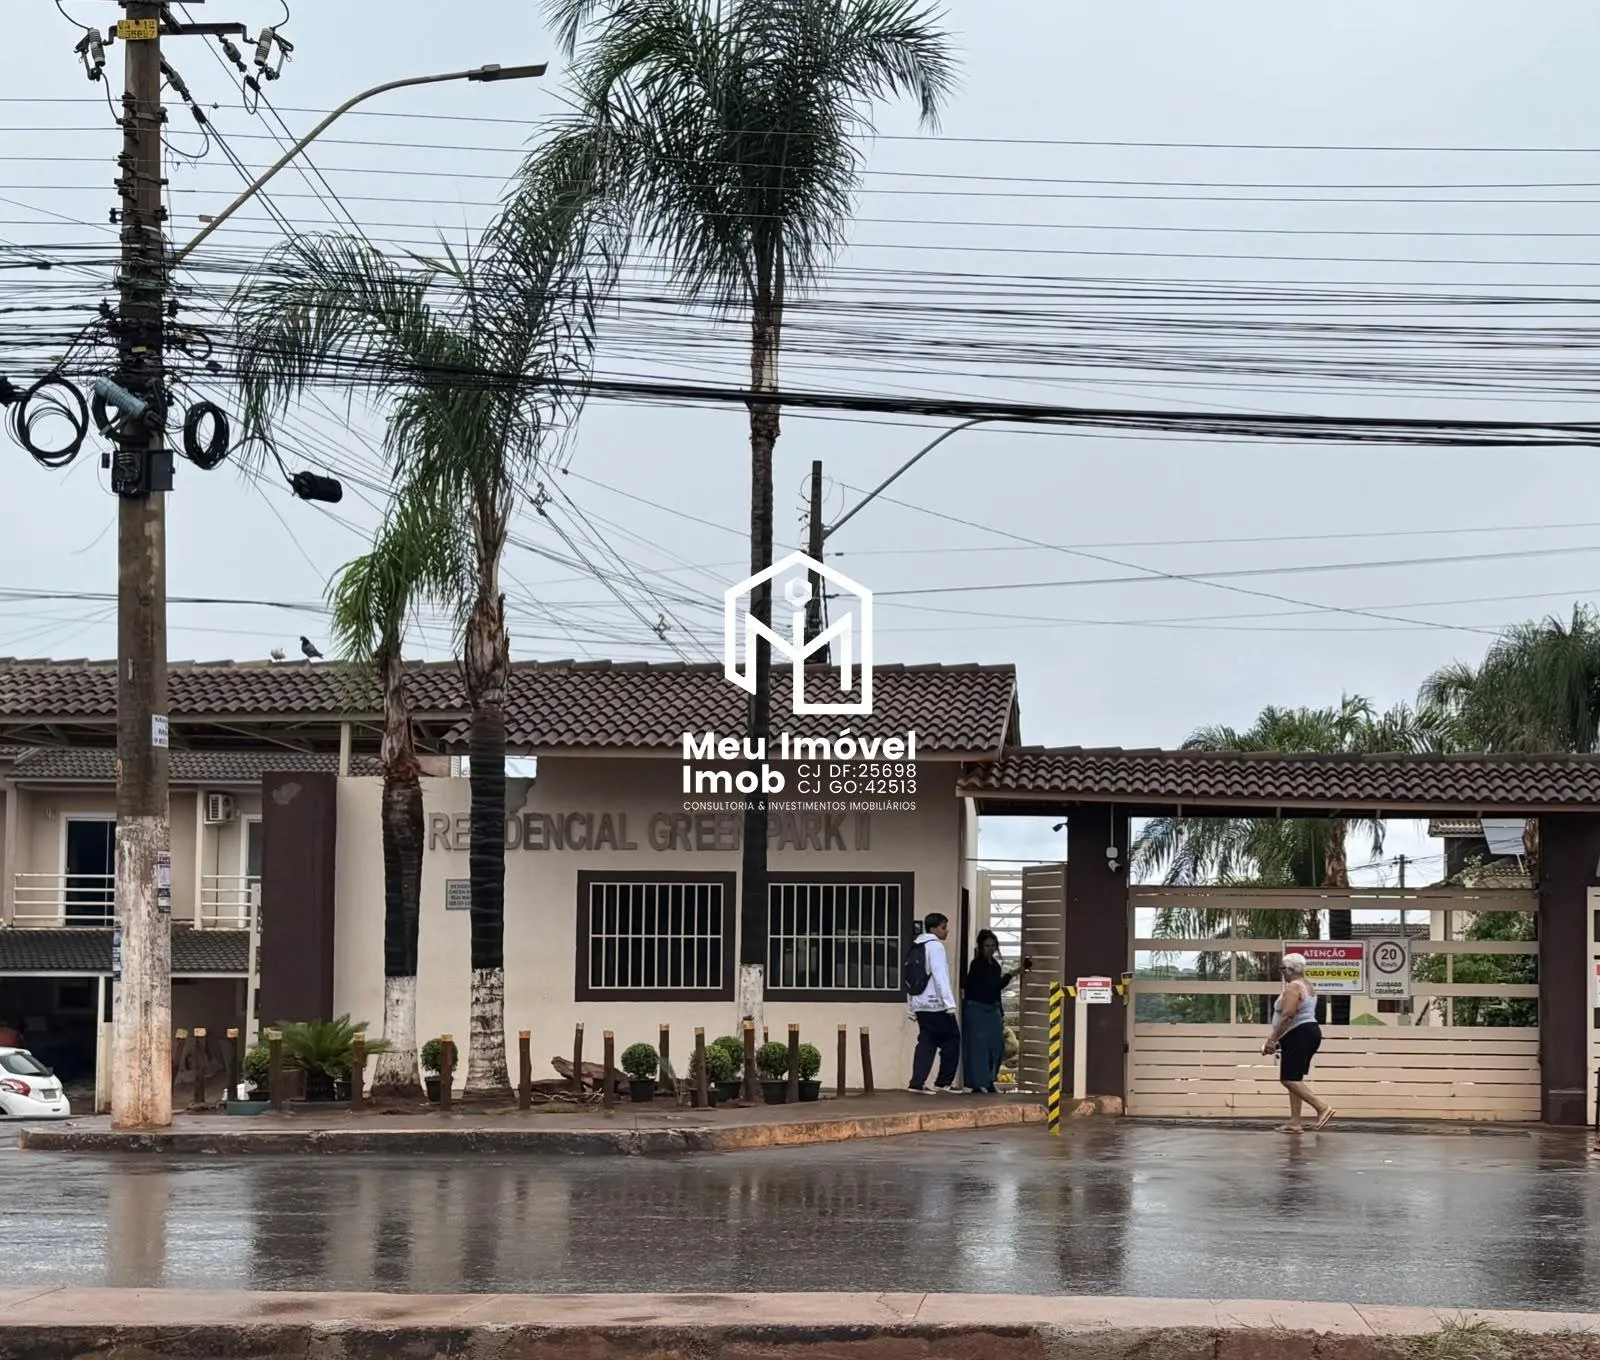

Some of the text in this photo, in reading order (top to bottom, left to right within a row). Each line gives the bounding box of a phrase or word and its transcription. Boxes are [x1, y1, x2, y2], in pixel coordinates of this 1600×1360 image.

[428, 812, 638, 851] REDENCIAL
[855, 812, 871, 851] II
[1303, 948, 1346, 958] ATENÇÃO
[1381, 949, 1397, 960] 20
